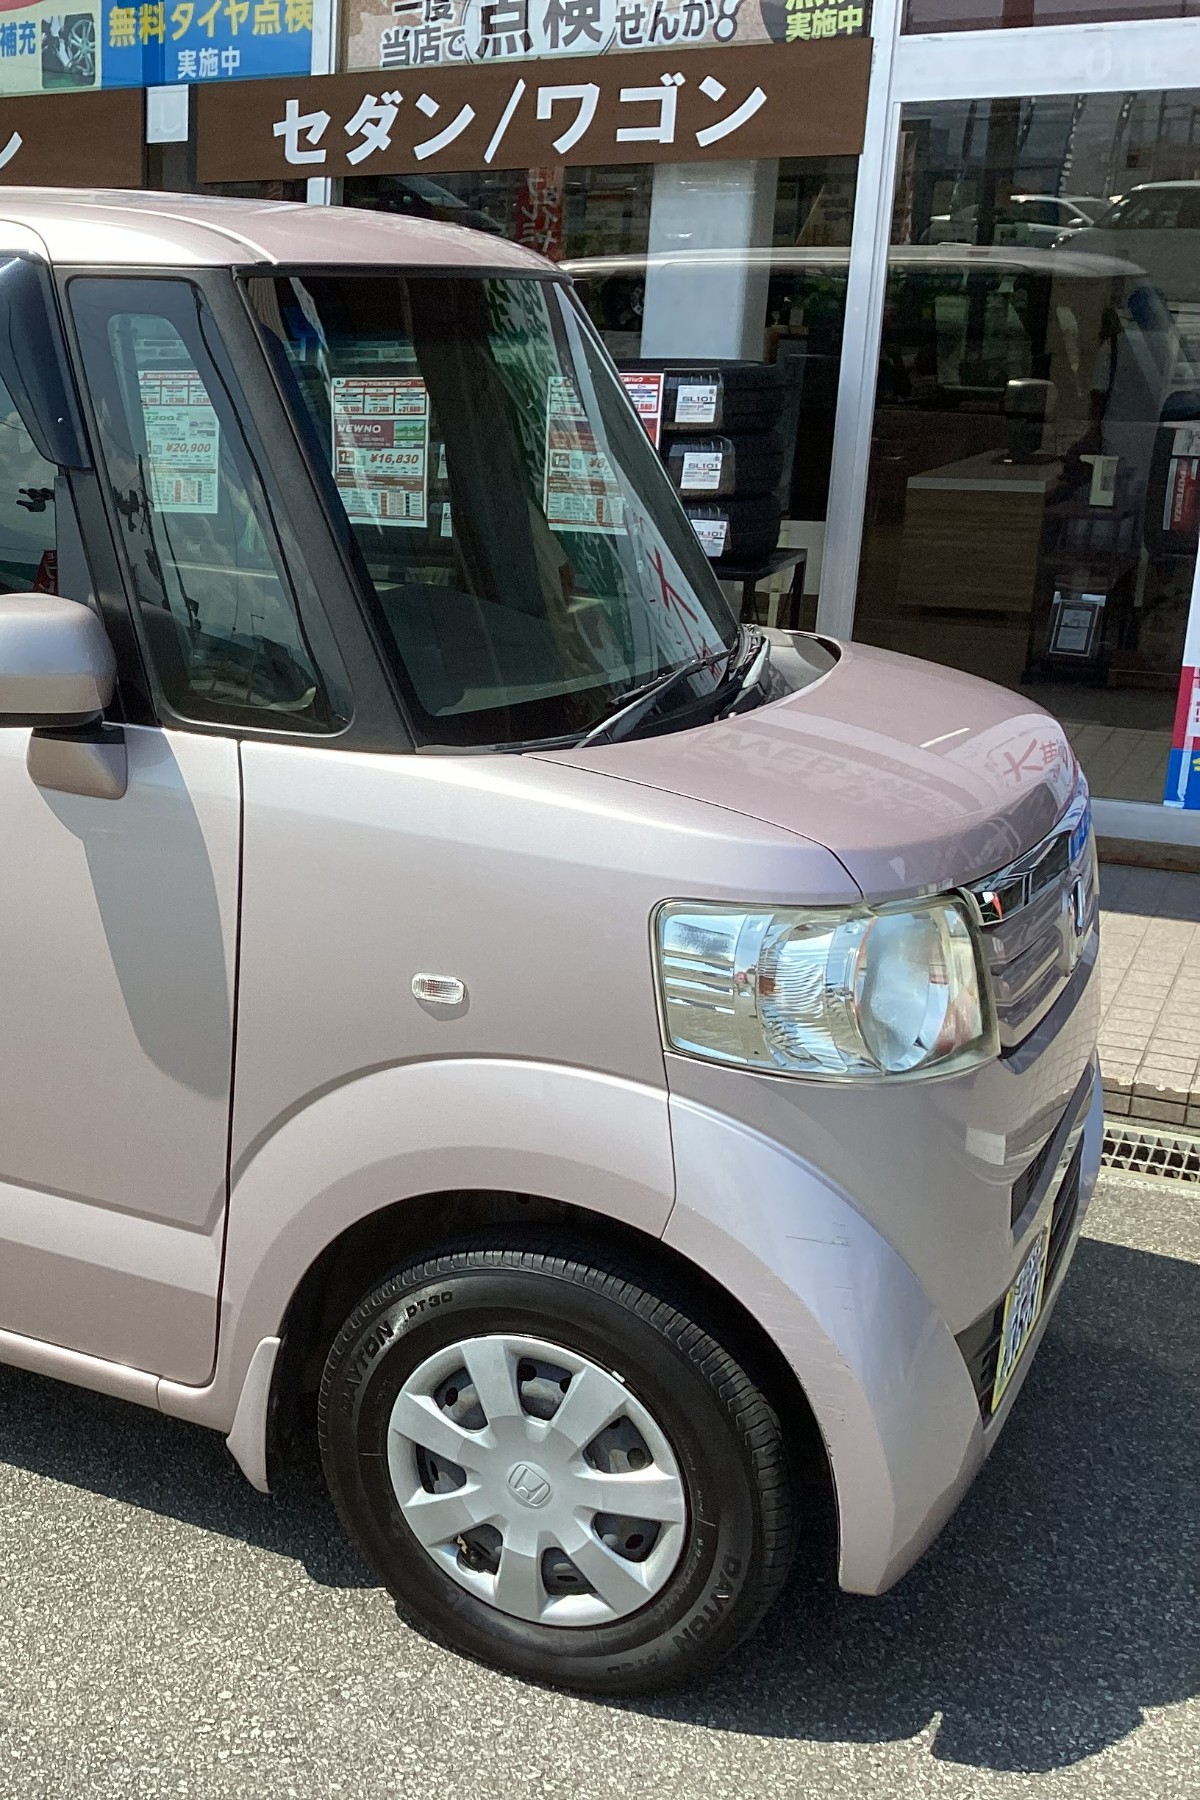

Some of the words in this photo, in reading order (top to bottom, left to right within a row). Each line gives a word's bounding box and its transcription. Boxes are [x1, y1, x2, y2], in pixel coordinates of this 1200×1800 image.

[108, 0, 314, 47] 無料タイヤ点検
[786, 5, 863, 42] 実施中
[382, 24, 465, 67] 当店で
[177, 48, 241, 80] 実施中
[337, 424, 381, 433] NEWNO
[166, 443, 211, 454] ¥20,900
[370, 453, 419, 465] ¥16,830
